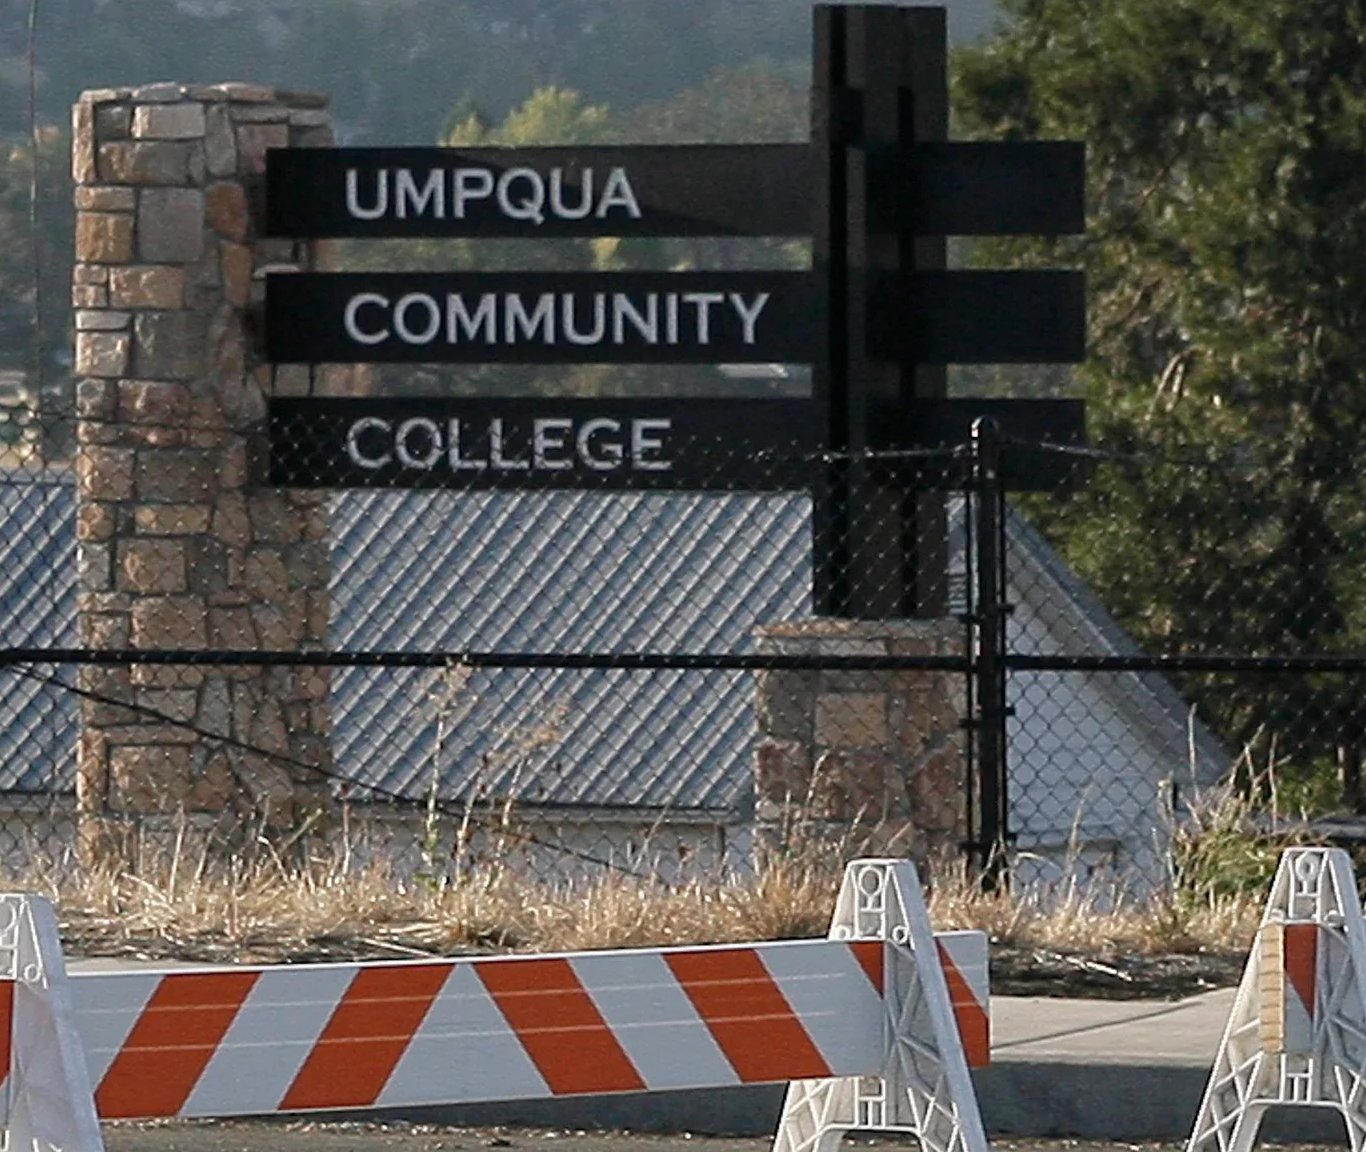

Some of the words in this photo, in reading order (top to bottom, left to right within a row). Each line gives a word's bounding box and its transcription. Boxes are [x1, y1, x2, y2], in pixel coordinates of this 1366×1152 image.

[344, 167, 643, 225] UMPQUA
[343, 291, 771, 345] COMMUNITY
[346, 416, 672, 471] COLLEGE
